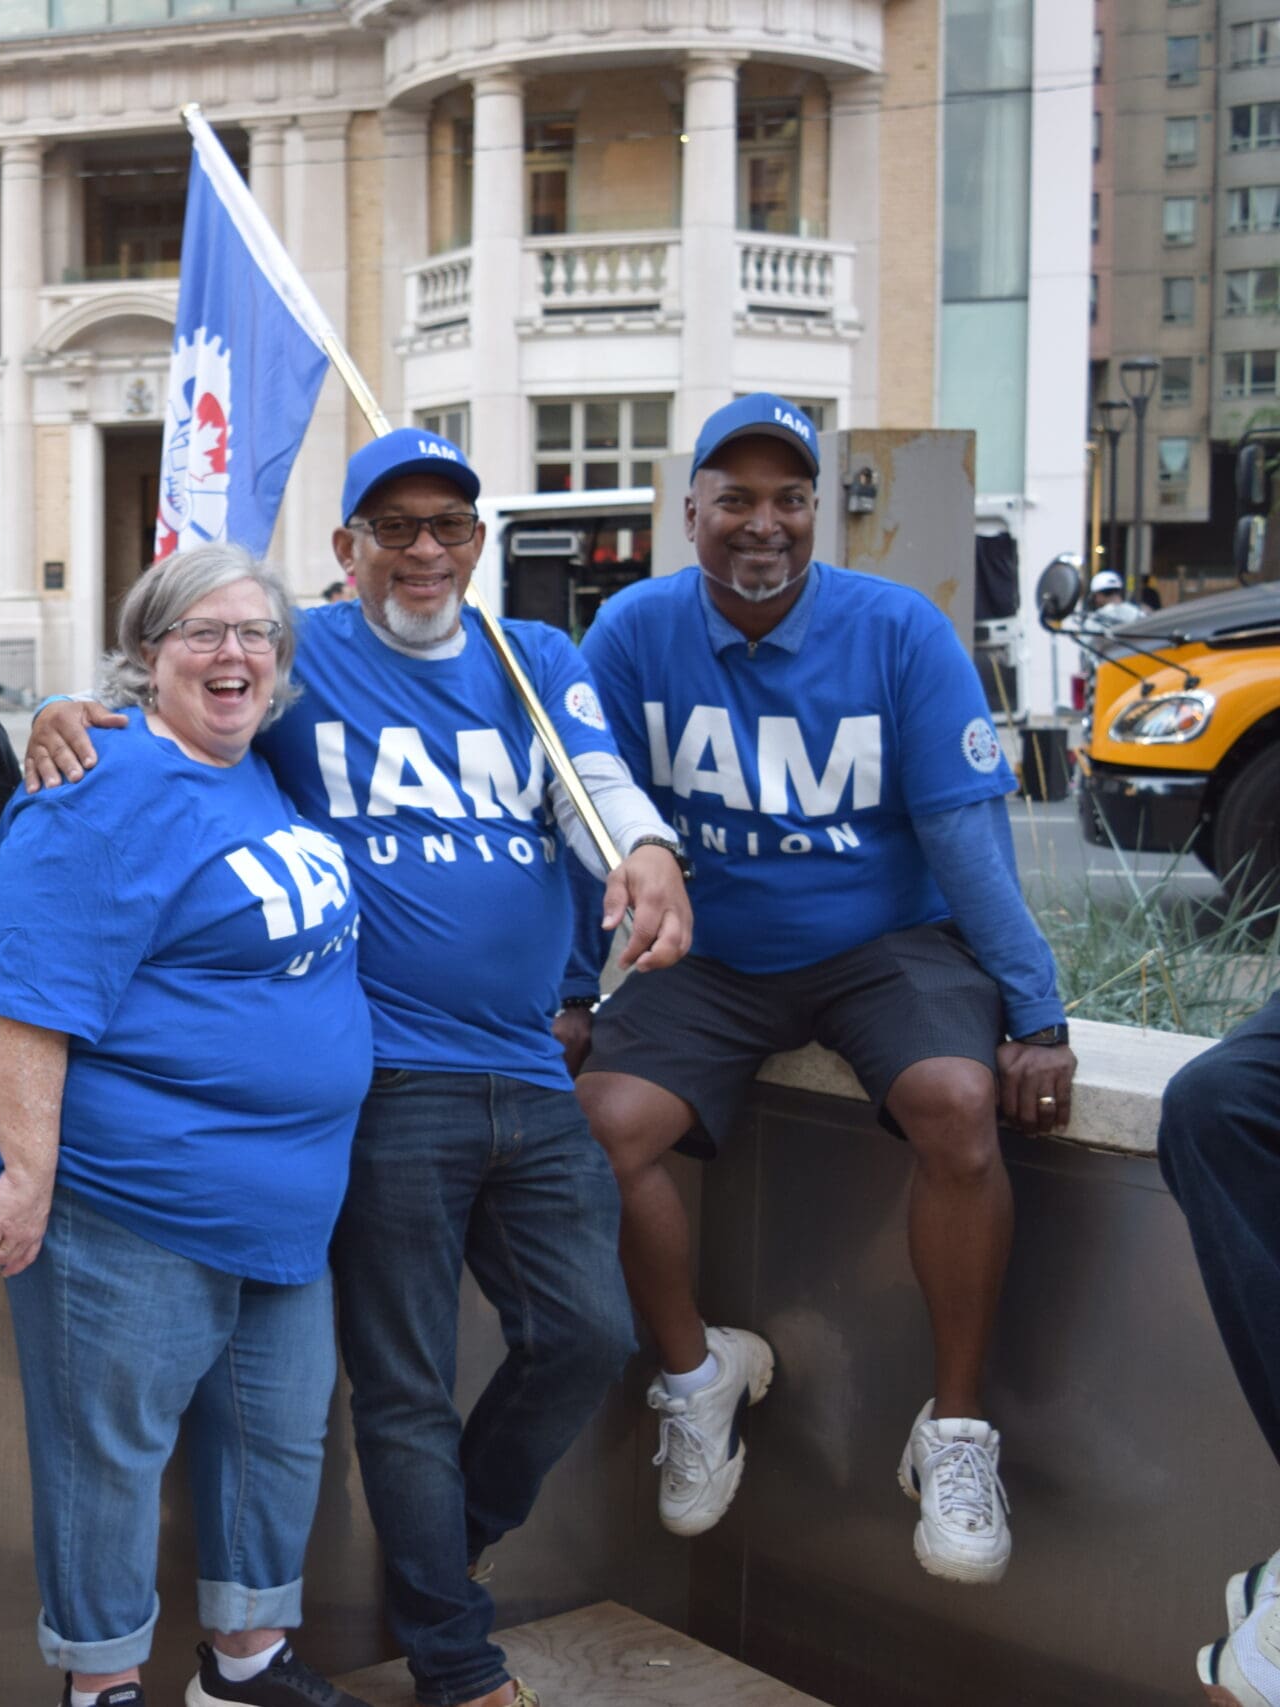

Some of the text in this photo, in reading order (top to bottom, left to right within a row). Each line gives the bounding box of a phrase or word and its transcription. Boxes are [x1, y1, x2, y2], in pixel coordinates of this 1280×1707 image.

[774, 407, 810, 440] IAM
[418, 440, 458, 461] IAM
[315, 721, 546, 821] IAM
[644, 702, 881, 816] IAM
[673, 812, 860, 856] UNION
